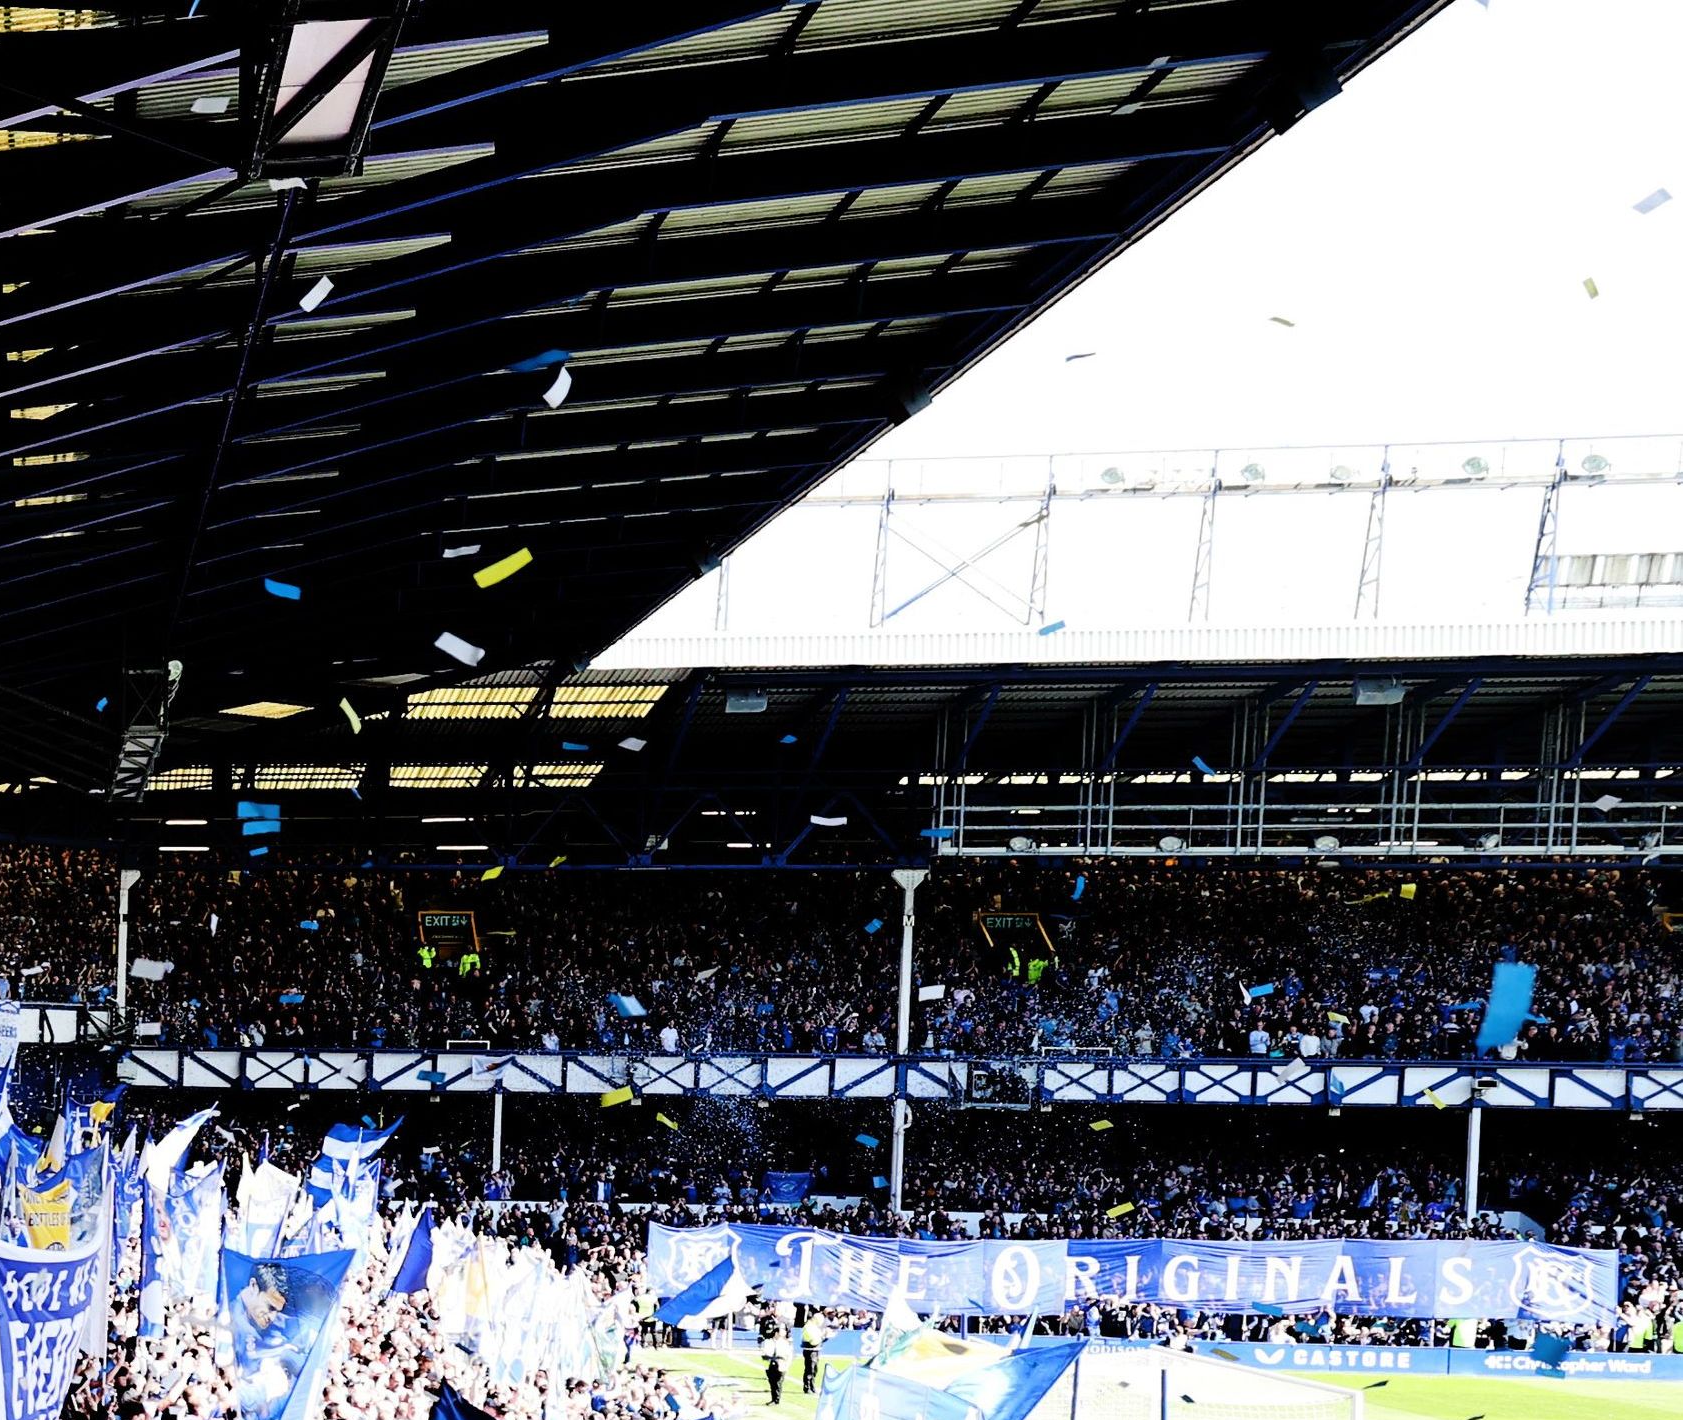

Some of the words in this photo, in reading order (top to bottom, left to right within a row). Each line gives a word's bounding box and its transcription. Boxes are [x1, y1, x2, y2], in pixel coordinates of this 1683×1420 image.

[425, 916, 451, 926] EXIT
[903, 915, 914, 926] M
[986, 917, 1013, 928] EXIT
[775, 1229, 928, 1302] THE
[991, 1245, 1475, 1310] ORIGINALS
[1293, 1350, 1411, 1369] CASTORE
[1608, 1359, 1652, 1374] Ward
